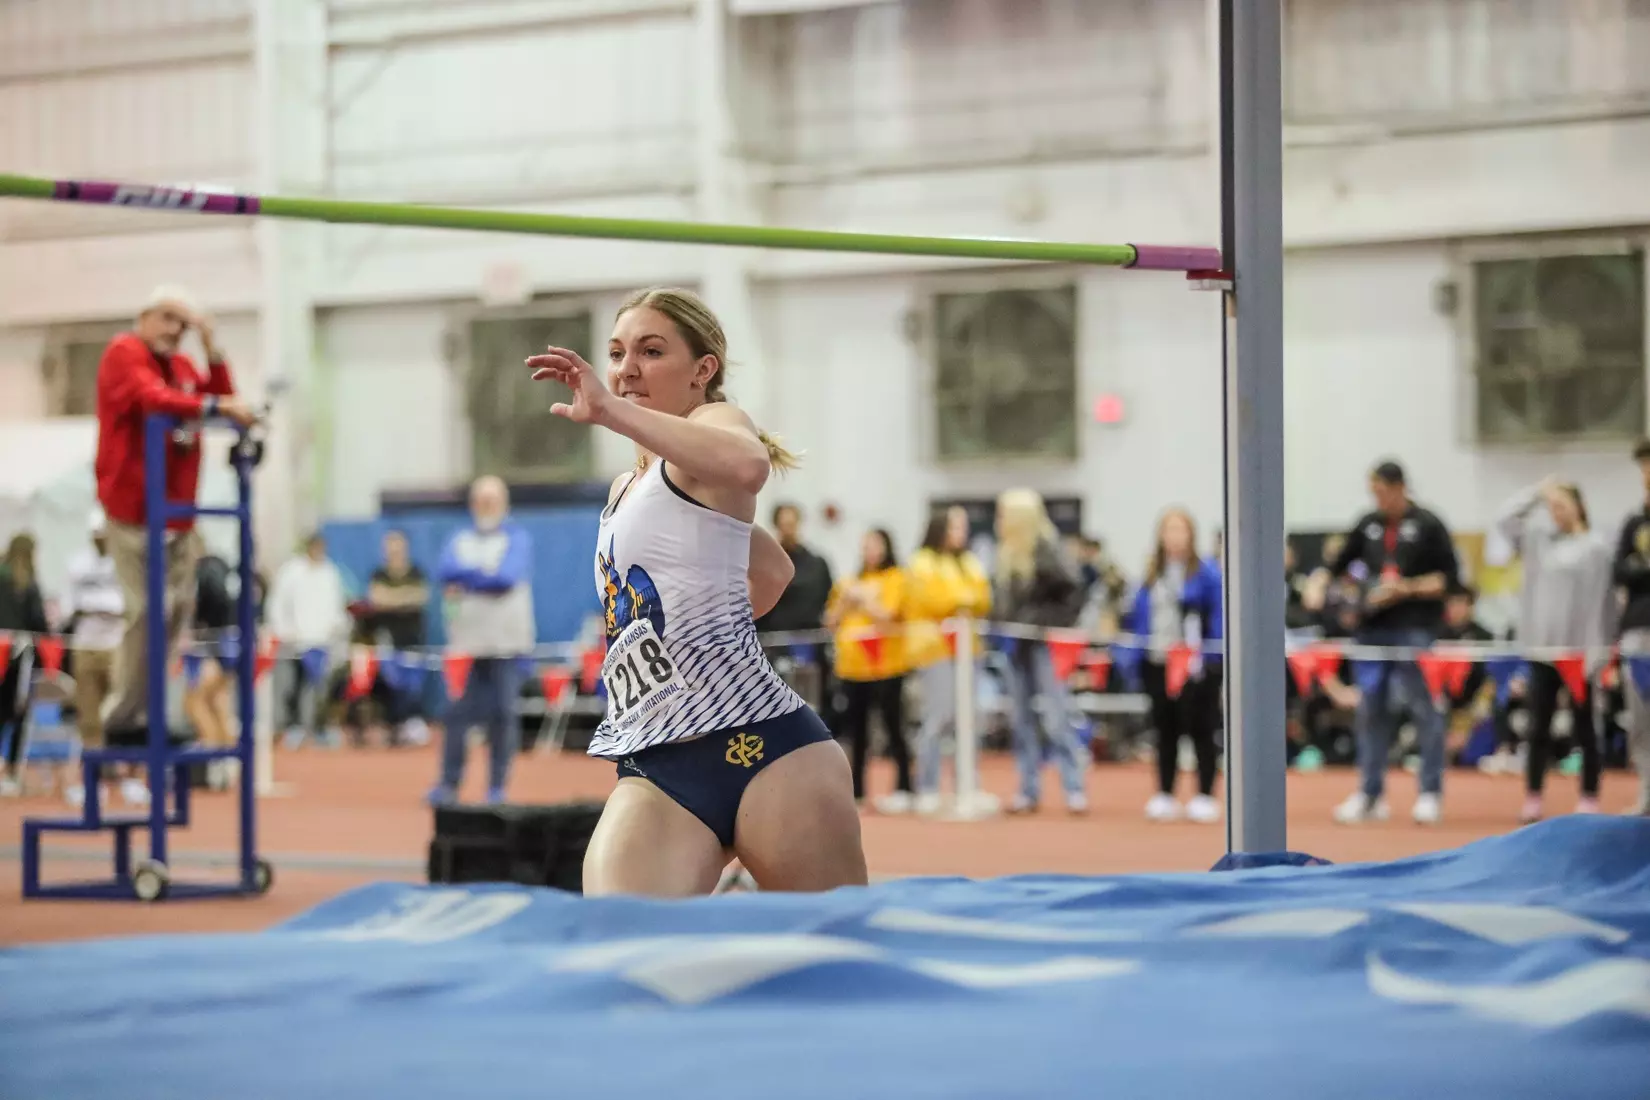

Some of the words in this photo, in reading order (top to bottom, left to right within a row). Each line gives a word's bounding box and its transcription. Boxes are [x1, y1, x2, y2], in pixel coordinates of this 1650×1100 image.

[624, 624, 648, 648] KANSAS
[608, 638, 673, 721] 1218
[639, 682, 681, 717] INVITATIONAL
